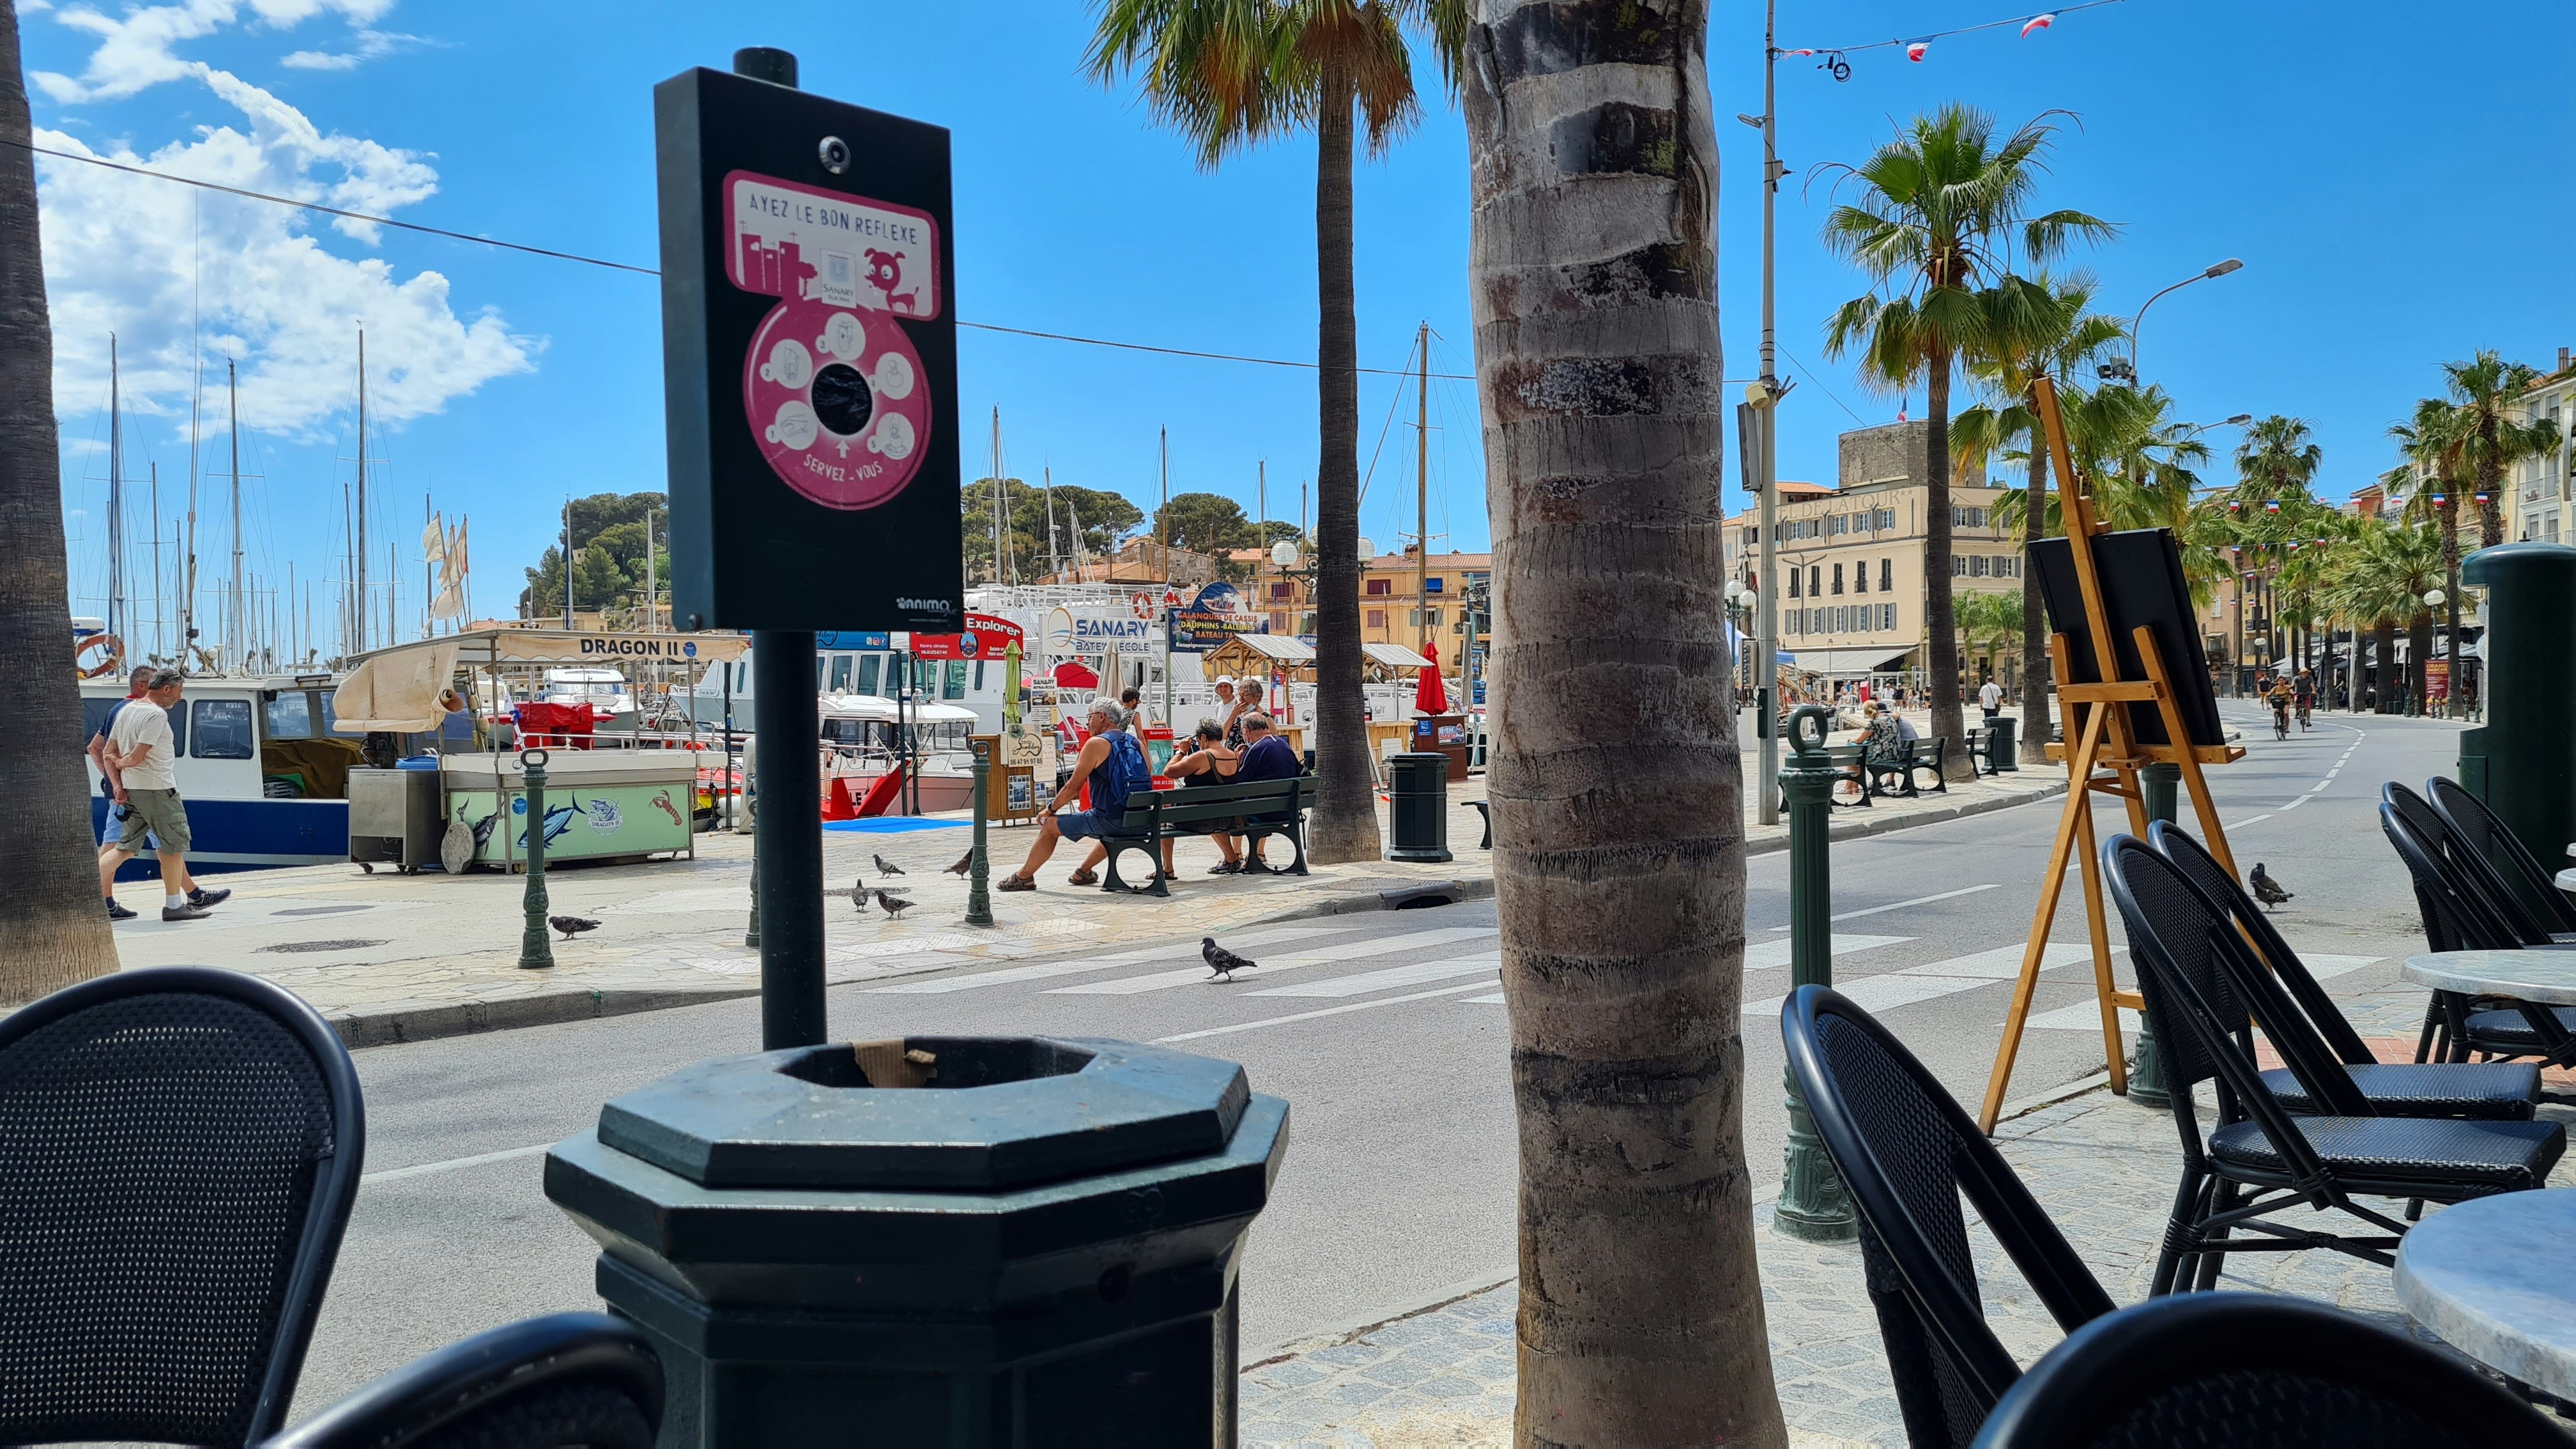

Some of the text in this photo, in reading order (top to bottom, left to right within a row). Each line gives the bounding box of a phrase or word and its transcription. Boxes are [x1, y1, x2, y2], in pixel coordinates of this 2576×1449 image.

[749, 194, 917, 245] AYEZ LE BON REFLEXE
[804, 454, 845, 482] SERVEZ
[855, 461, 883, 480] VOUS
[1802, 501, 1823, 517] DE
[1177, 611, 1222, 620] CALANQUES
[966, 617, 1020, 636] Explorer
[1077, 619, 1149, 637] SANARY
[1181, 621, 1220, 629] DAUPHINS
[1195, 631, 1223, 639] BATEAU
[580, 639, 661, 656] DRAGON
[667, 641, 678, 656] II
